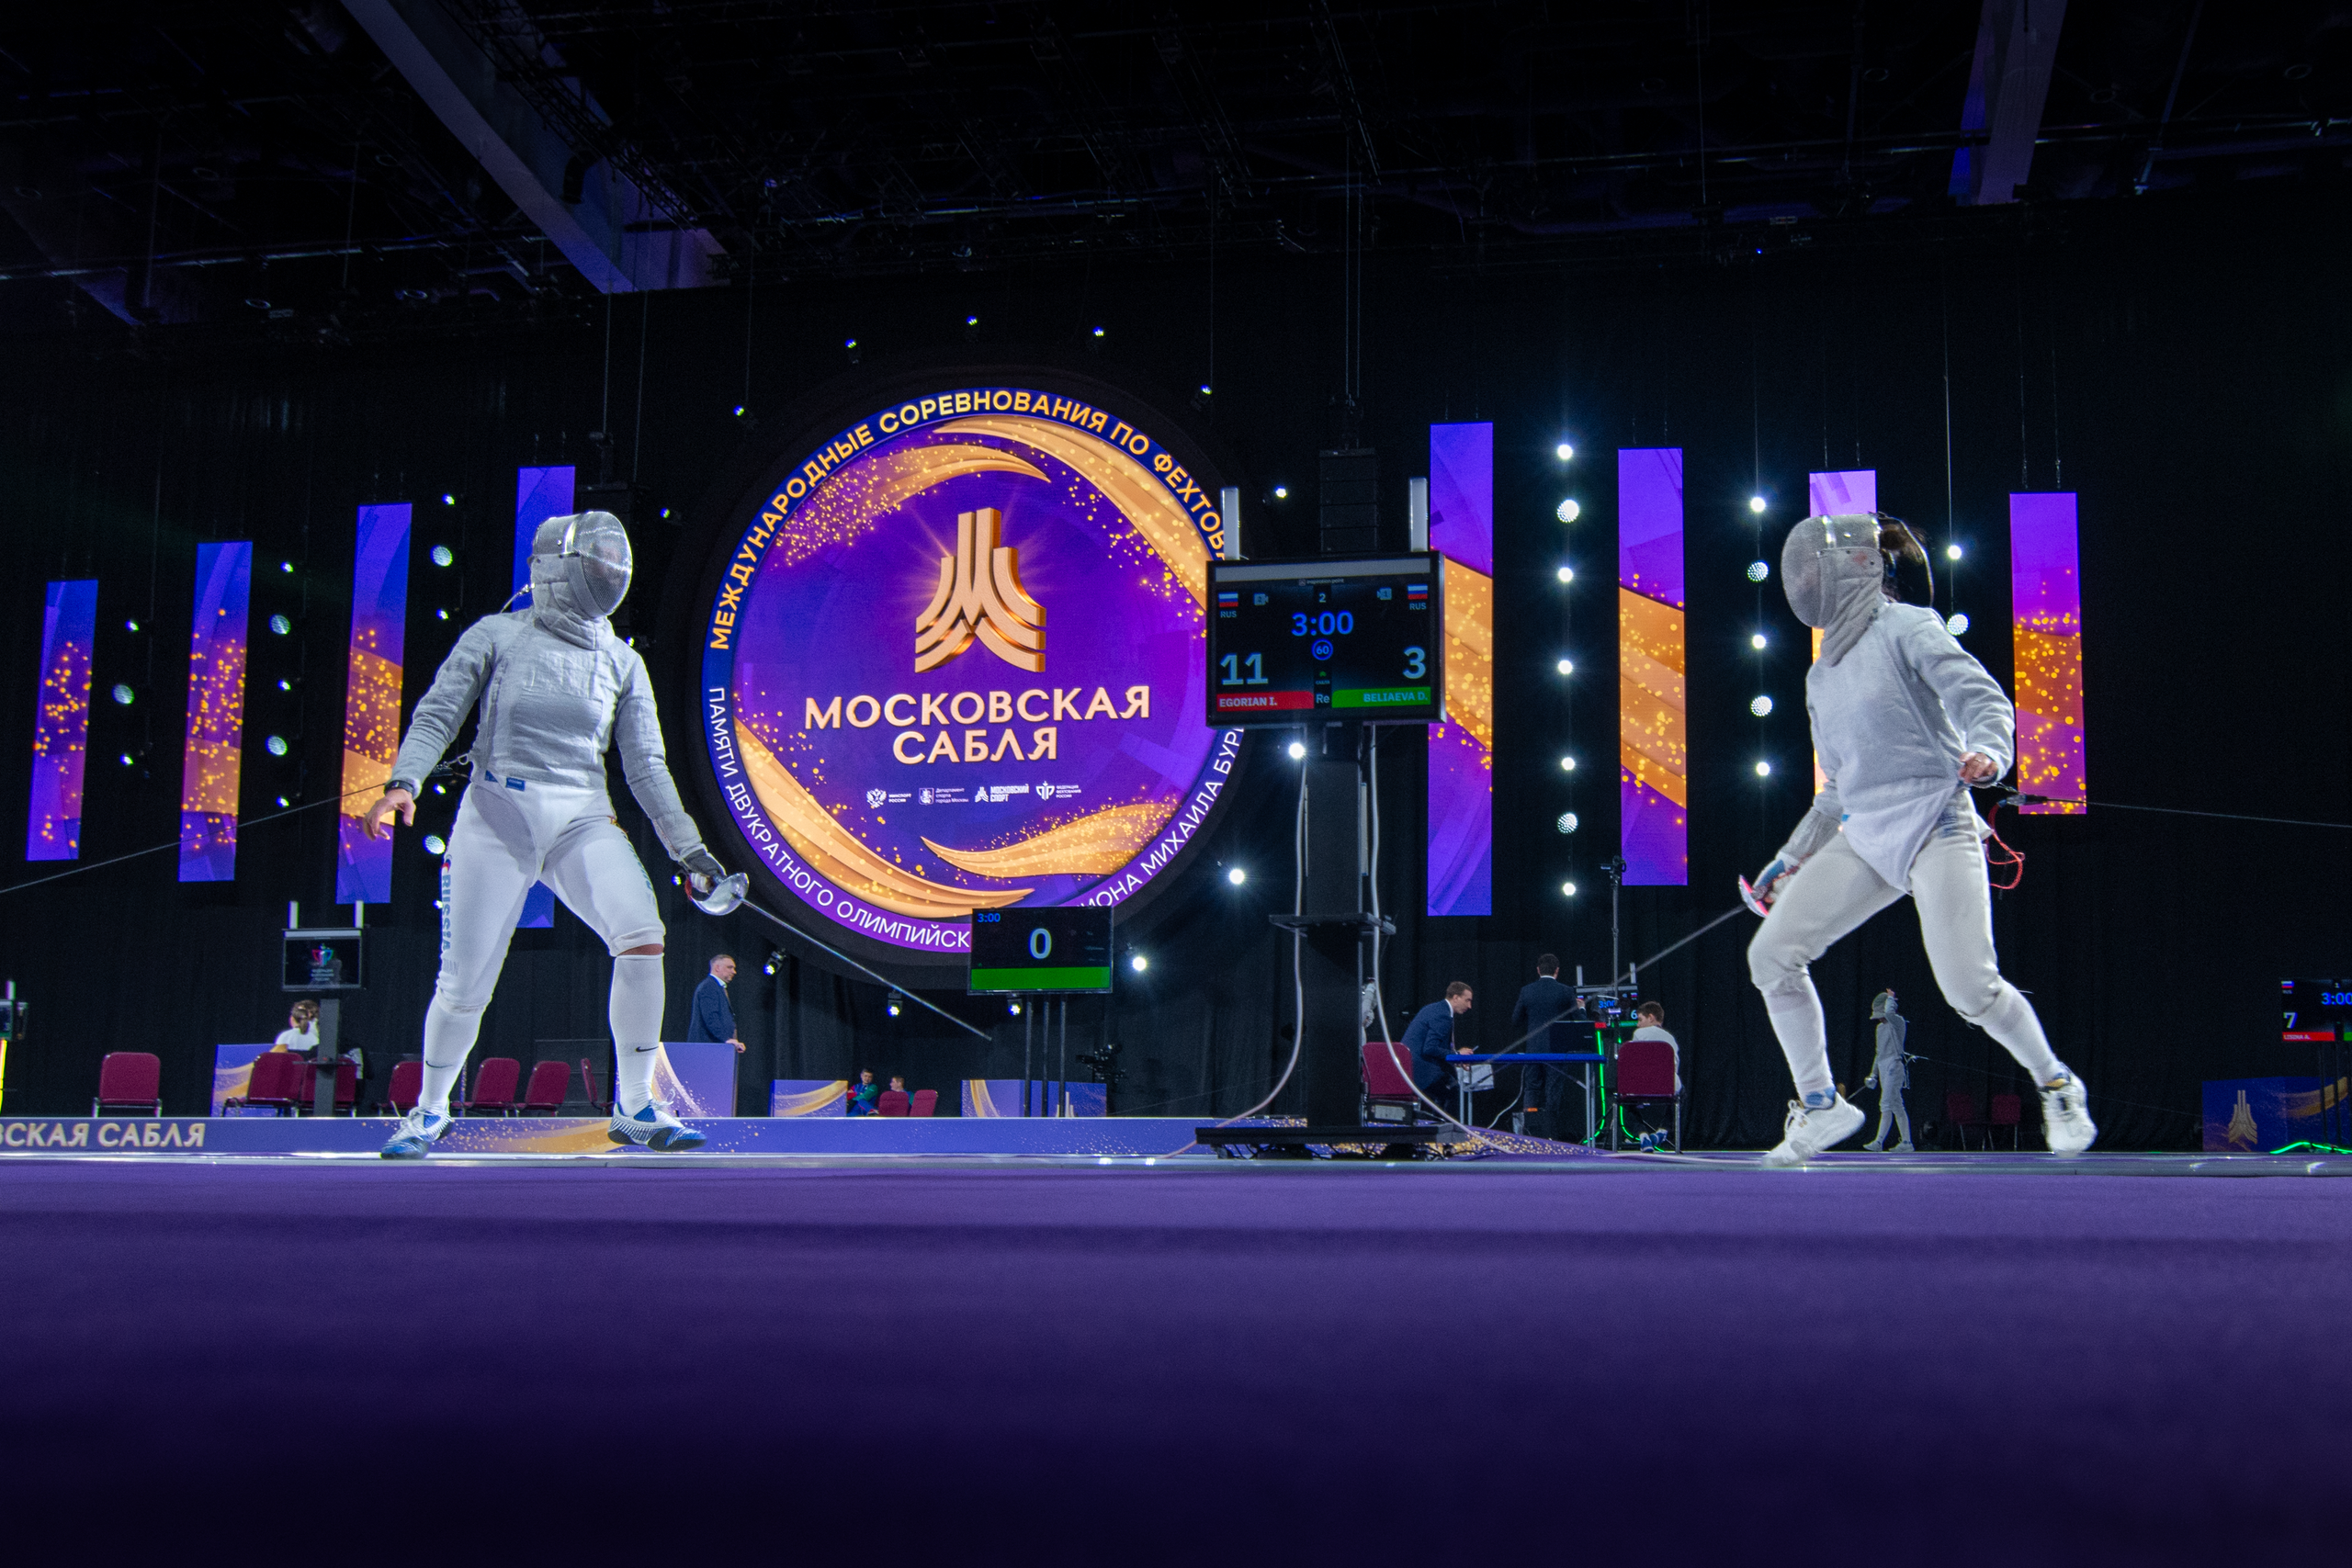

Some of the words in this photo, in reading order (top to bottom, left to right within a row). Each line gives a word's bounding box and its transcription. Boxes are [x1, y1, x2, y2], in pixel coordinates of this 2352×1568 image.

[710, 428, 875, 649] МЕЖДУНАРОДНЫЕ
[878, 390, 1109, 434] СОРЕВНОВАНИЯ
[1109, 419, 1150, 456] ПО
[1153, 453, 1225, 561] ФЕХТОВ
[1318, 592, 1327, 604] 2
[1408, 602, 1427, 610] RUS
[1291, 610, 1354, 637] 3:00
[1315, 645, 1329, 656] 60
[1219, 652, 1269, 686] 11
[1402, 647, 1426, 680] 3
[804, 685, 1150, 730] МОСКОВСКАЯ
[1219, 697, 1267, 707] EGORIAN
[1269, 696, 1278, 706] I.
[1316, 694, 1330, 704] Re
[1363, 692, 1415, 703] BELIAEVA
[1418, 691, 1428, 701] D.
[892, 727, 1057, 765] САБЛЯ
[708, 687, 739, 778] ПАМЯТИ
[727, 784, 834, 907] ДВУКРАТНОГО
[1140, 780, 1223, 875] МИХАИЛА
[1213, 728, 1244, 775] БУР
[989, 784, 1030, 795] МОСКОВСКИЙ
[989, 794, 1010, 803] СПОРТ
[441, 874, 451, 951] RUSSIA
[978, 913, 1001, 922] 3:00
[1028, 928, 1052, 959] 0
[2283, 1011, 2298, 1029] 7
[0, 1122, 89, 1147] СКАЯ
[97, 1122, 206, 1147] САБЛЯ
